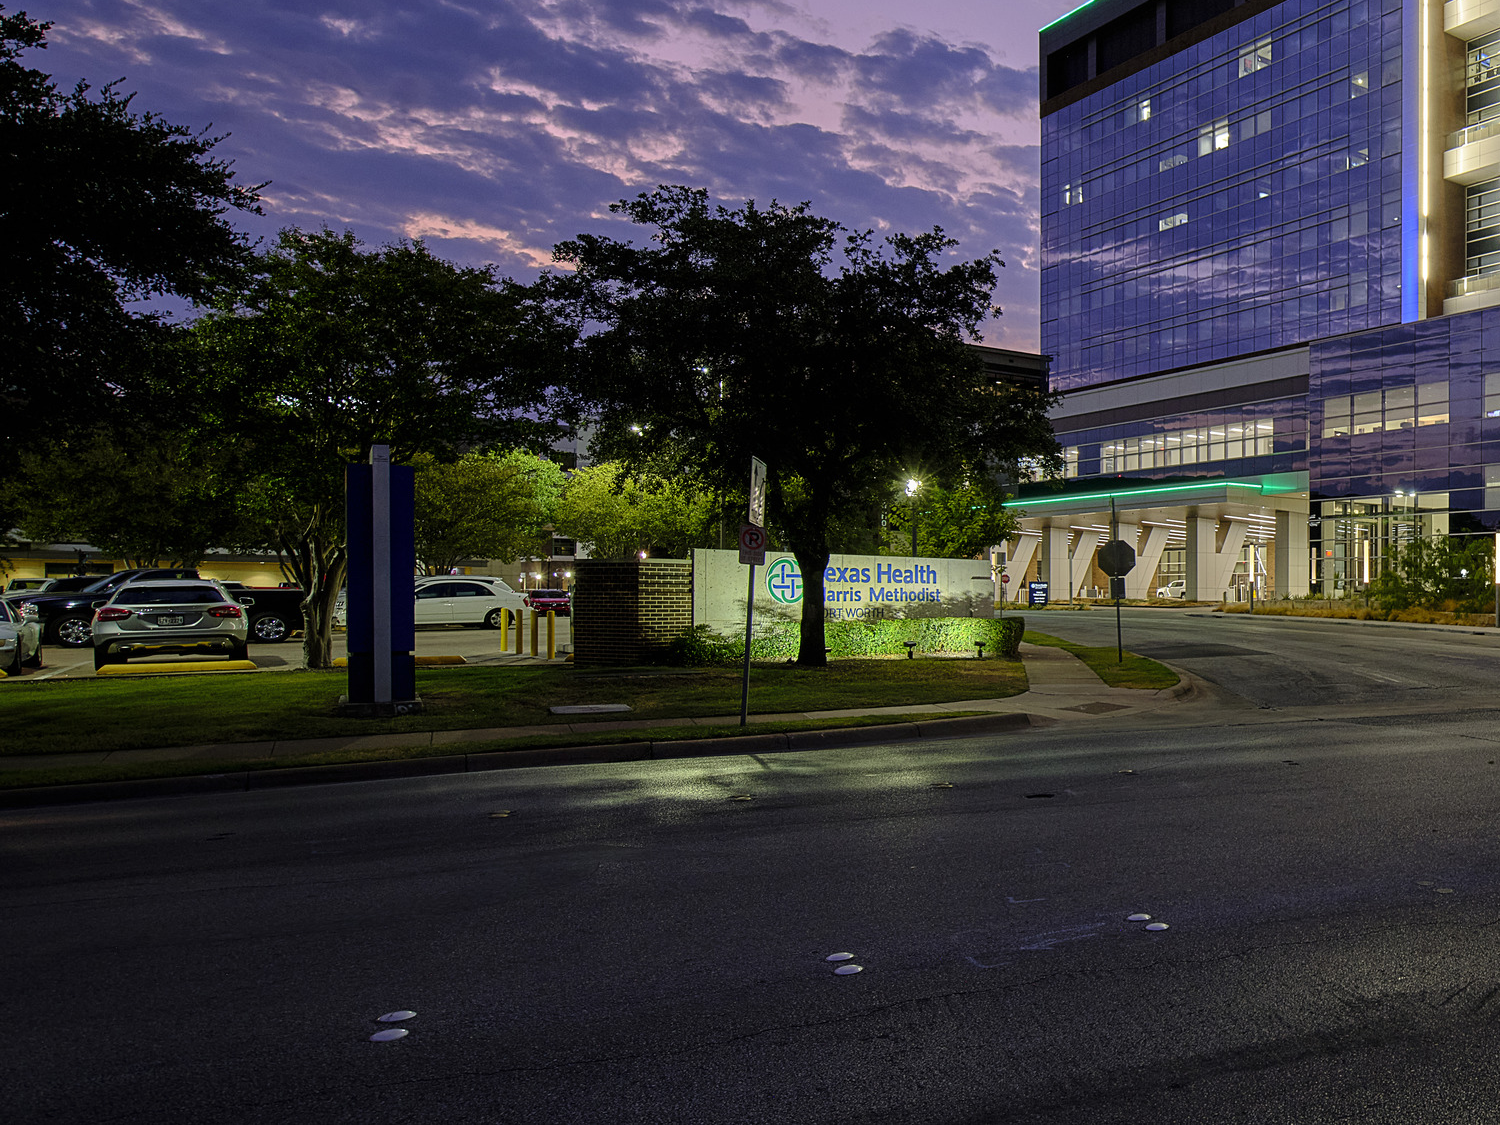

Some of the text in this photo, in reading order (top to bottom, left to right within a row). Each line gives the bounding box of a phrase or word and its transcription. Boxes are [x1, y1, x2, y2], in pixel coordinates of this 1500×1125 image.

[823, 563, 937, 584] exas Health
[823, 586, 941, 602] arris Methodist
[823, 607, 884, 619] ORT WORTH
